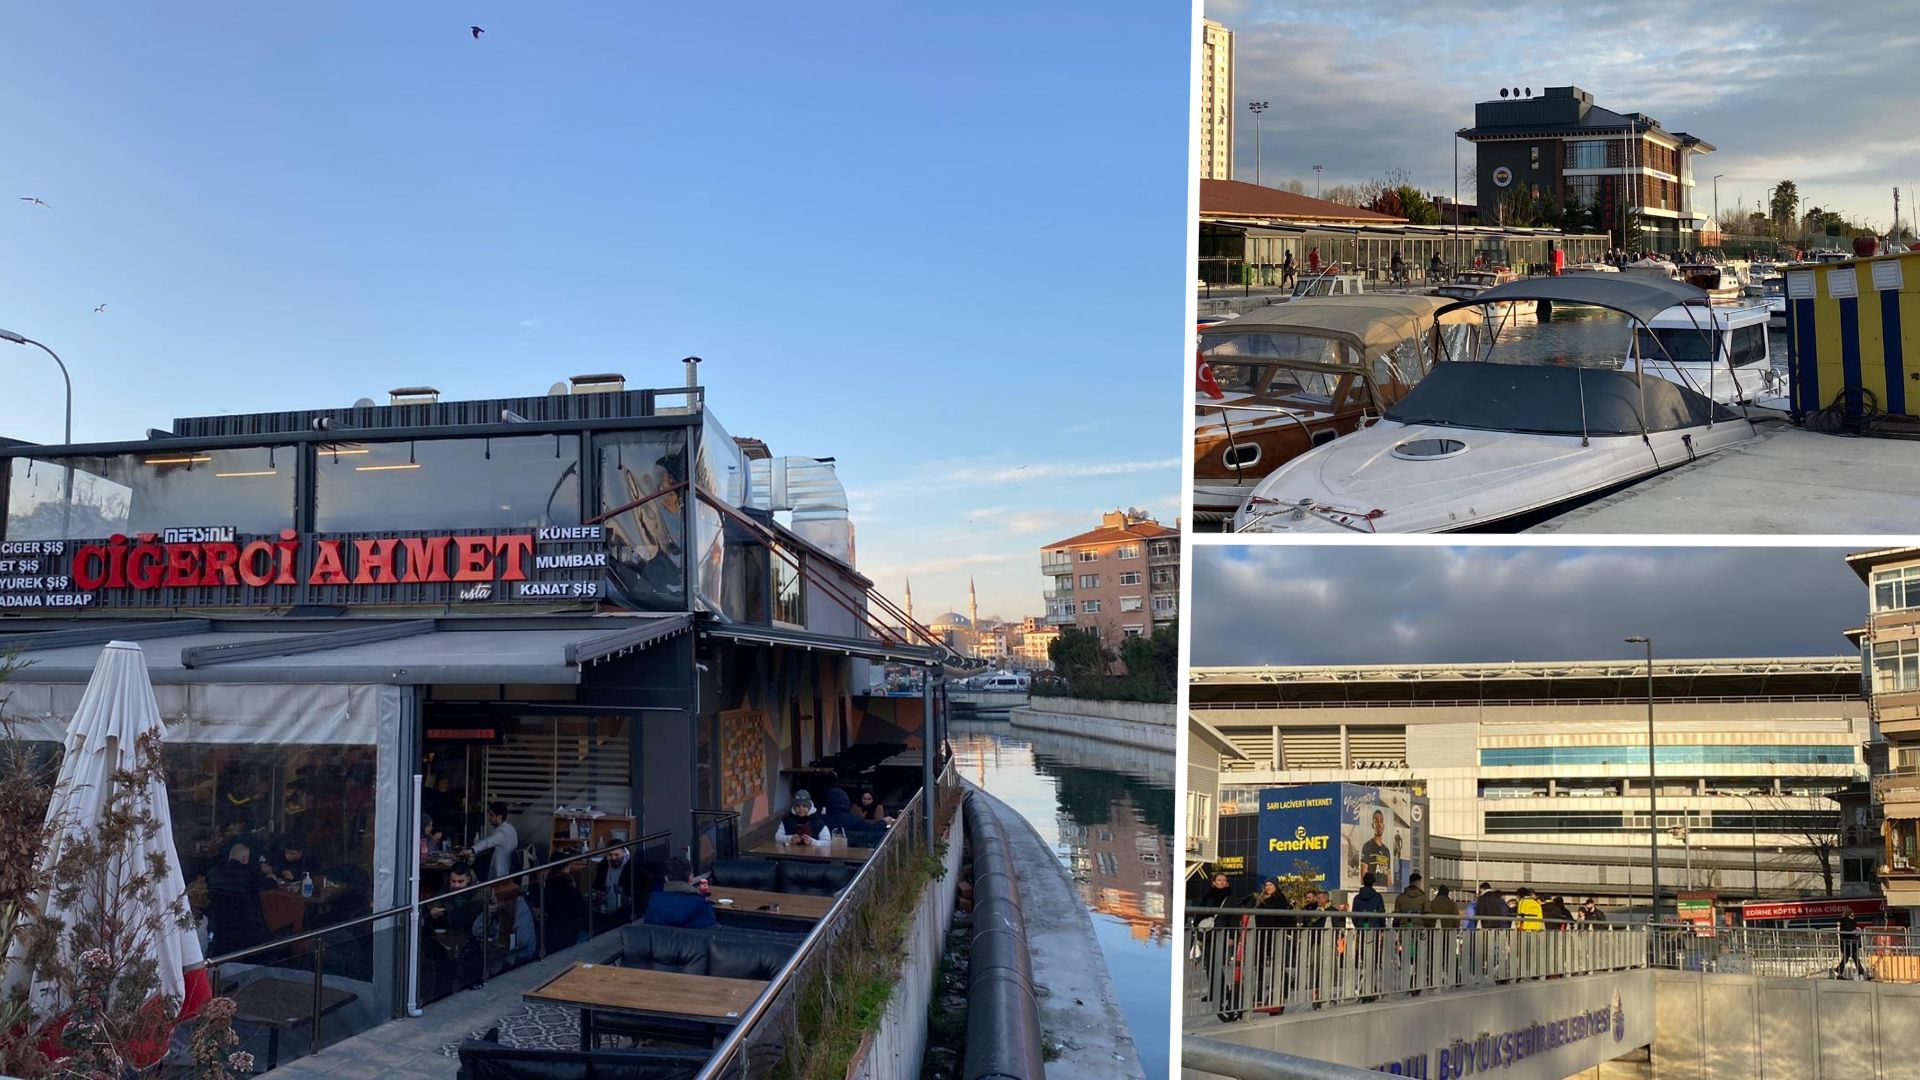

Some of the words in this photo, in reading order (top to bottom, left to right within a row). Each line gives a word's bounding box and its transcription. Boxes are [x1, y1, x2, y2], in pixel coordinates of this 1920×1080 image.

[539, 525, 600, 540] KÜNEFE
[0, 560, 16, 571] ET
[72, 528, 299, 590] CİĞERCİ
[308, 534, 533, 584] AHMET
[536, 553, 606, 569] MUMBAR
[460, 584, 491, 600] usta
[520, 583, 569, 595] KANAT
[572, 580, 597, 597] ŞİŞ
[0, 595, 42, 607] ADANA
[46, 594, 92, 606] KEBAP
[1266, 802, 1279, 810] SARI
[1269, 836, 1330, 852] FenerNET
[1745, 908, 1772, 917] EDİRNE
[1773, 906, 1797, 915] KÖFTE
[1804, 906, 1823, 914] TAVA
[1547, 1007, 1611, 1049] BELEDİYESİ
